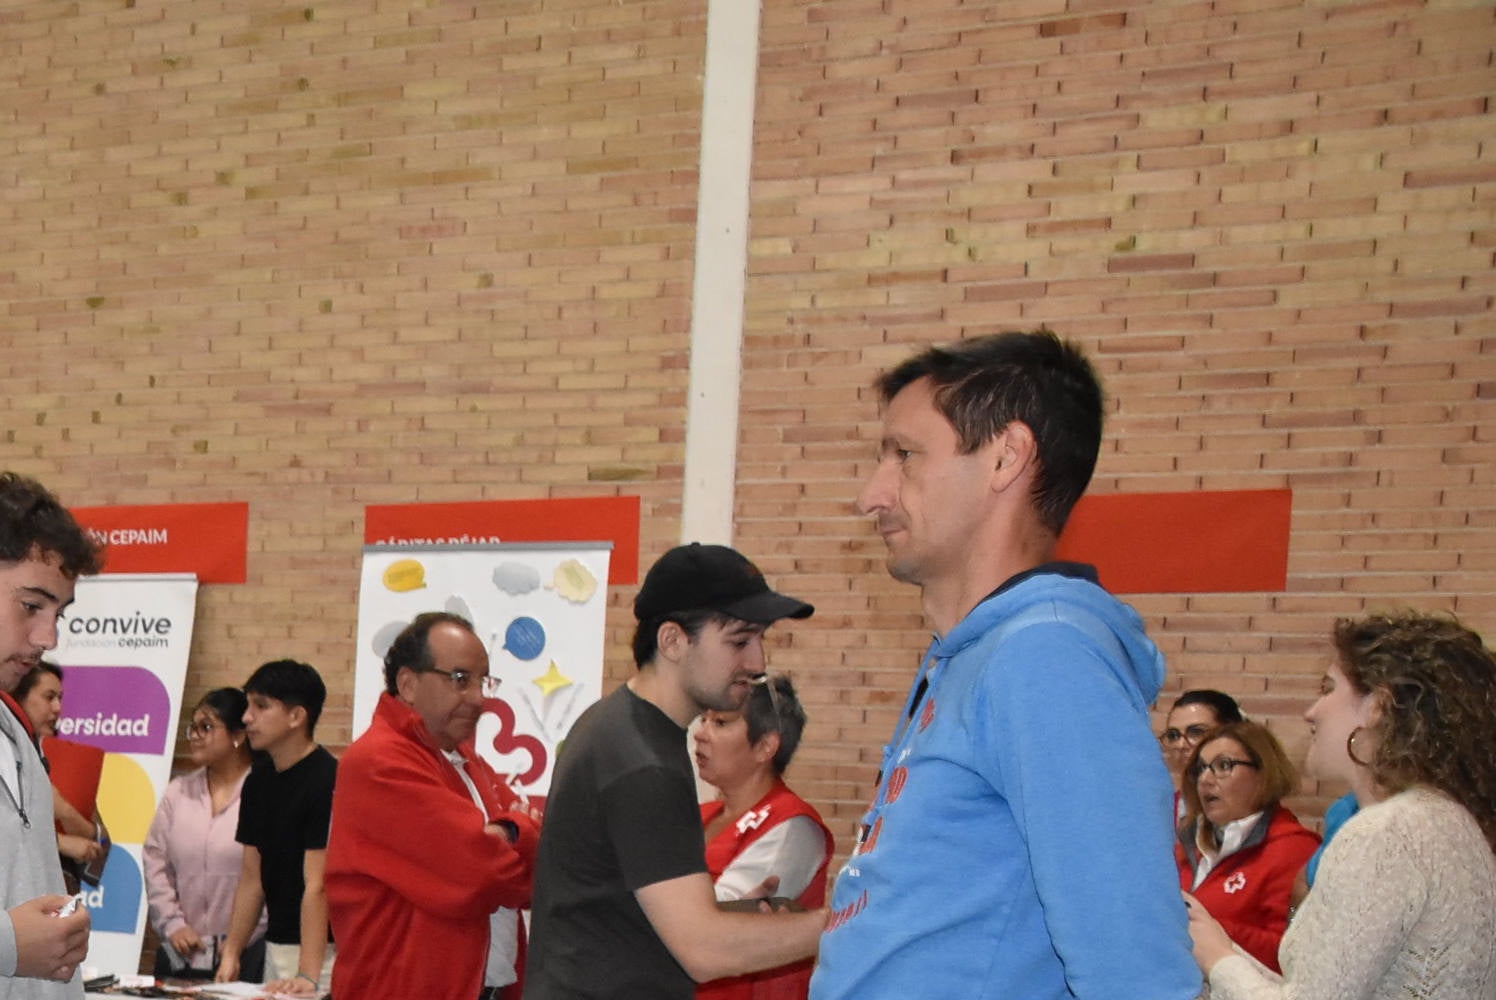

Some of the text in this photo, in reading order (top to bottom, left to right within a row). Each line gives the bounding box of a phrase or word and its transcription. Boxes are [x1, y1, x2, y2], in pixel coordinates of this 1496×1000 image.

[109, 527, 168, 546] CEPAIM
[69, 610, 172, 635] convive
[118, 634, 169, 651] cepaim
